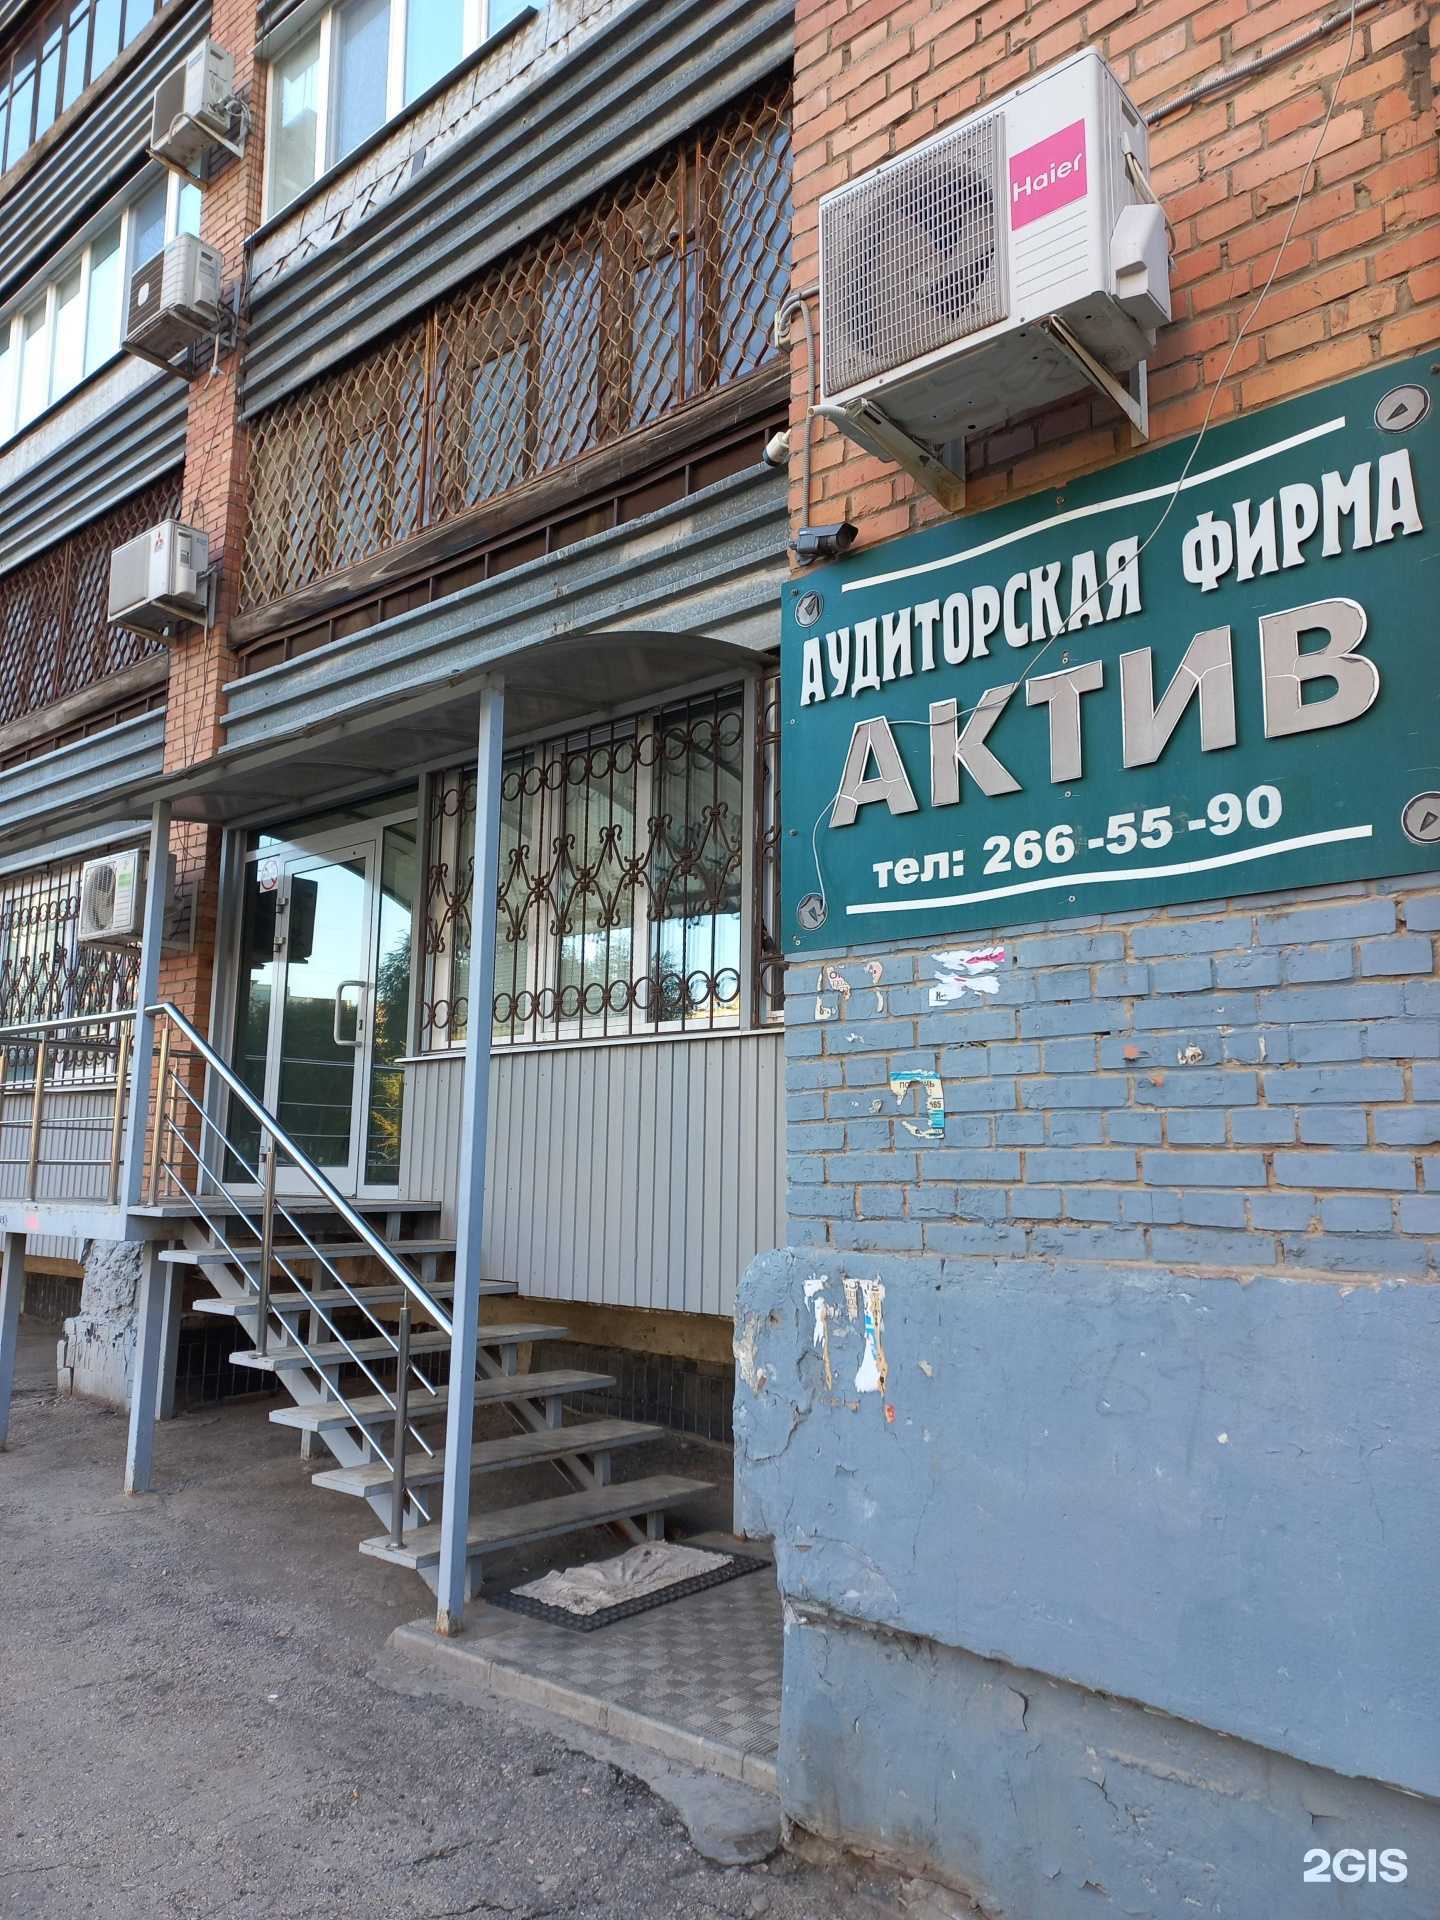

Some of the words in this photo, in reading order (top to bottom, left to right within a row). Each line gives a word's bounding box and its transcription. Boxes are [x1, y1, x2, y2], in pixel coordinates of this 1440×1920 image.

[1013, 153, 1082, 202] Haier
[800, 536, 1144, 706] АУДИТОРСКАЯ
[1181, 449, 1424, 592] ФИРМА
[829, 597, 1380, 829] АКТИВ
[872, 850, 964, 888] тел:
